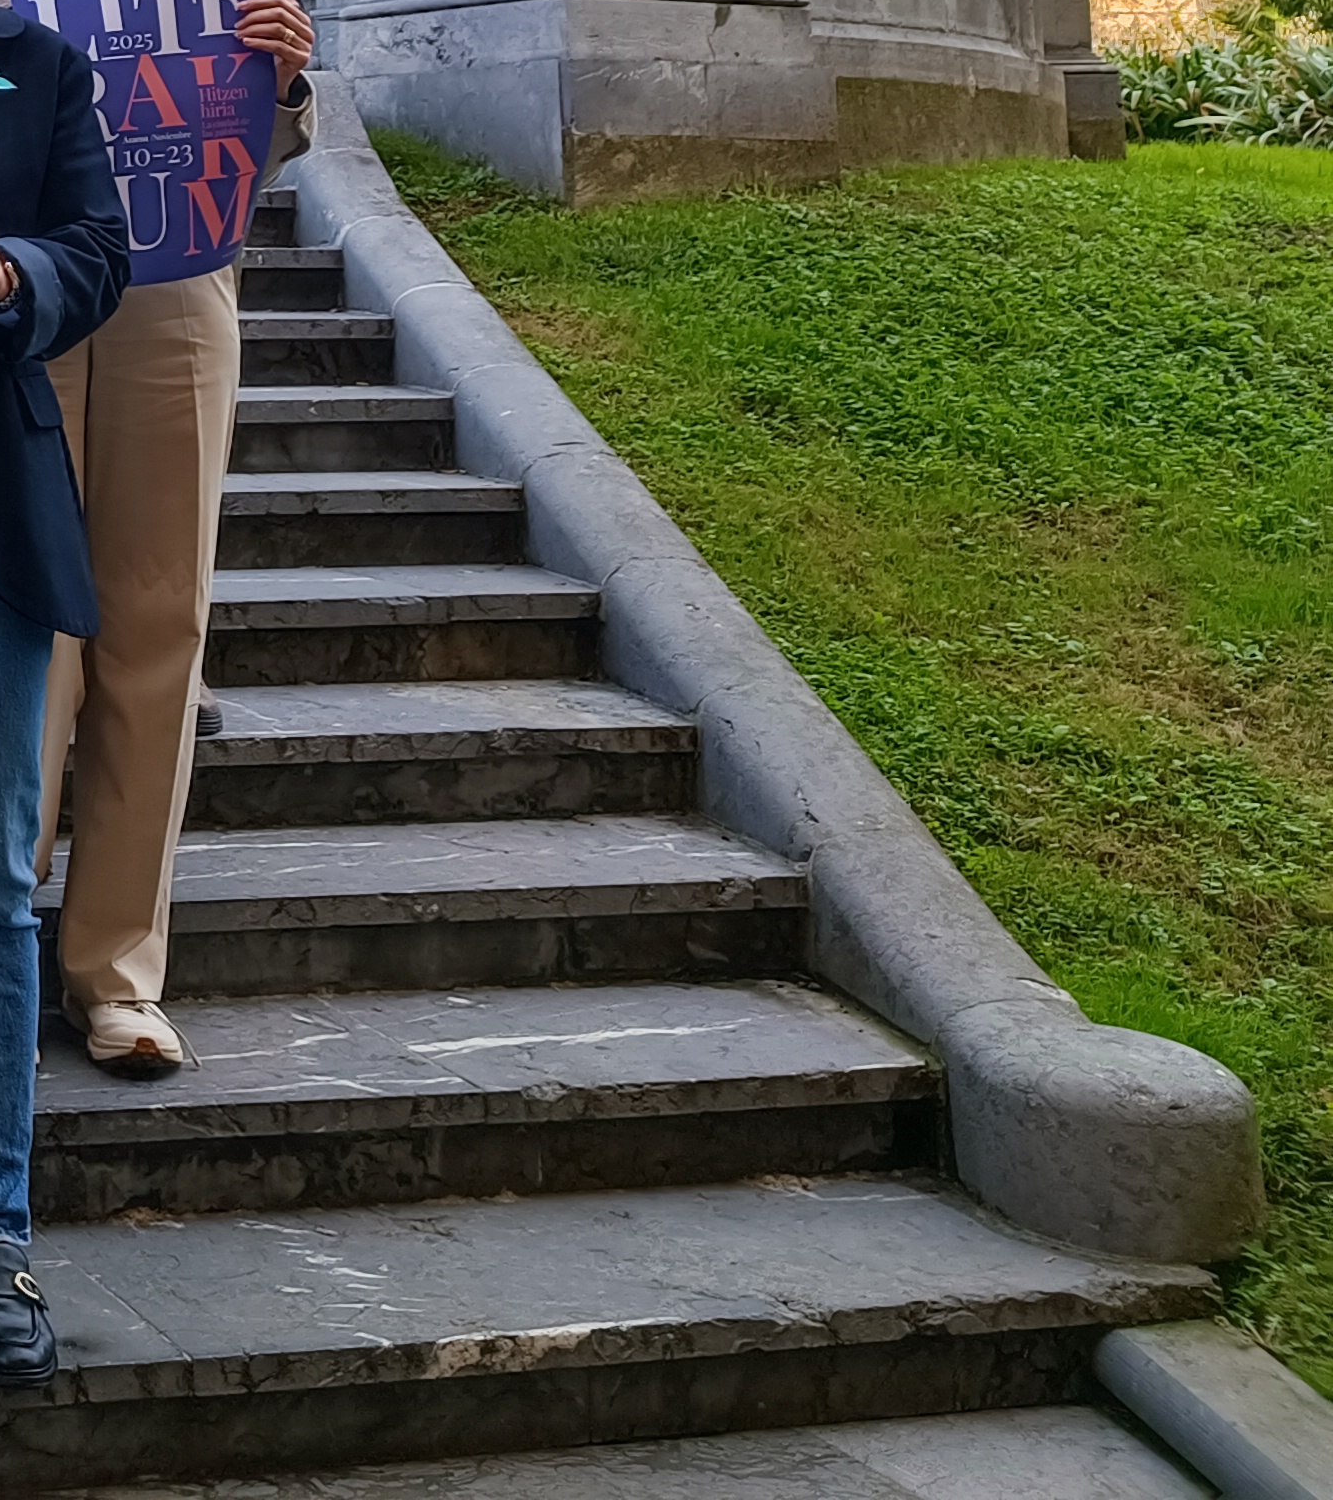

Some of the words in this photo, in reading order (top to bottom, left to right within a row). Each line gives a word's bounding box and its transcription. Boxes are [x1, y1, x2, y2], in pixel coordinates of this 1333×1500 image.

[108, 33, 154, 51] 2025
[199, 85, 249, 103] Hitzen
[200, 102, 236, 119] hiria
[122, 144, 194, 169] 10-23
[109, 150, 258, 256] UM
